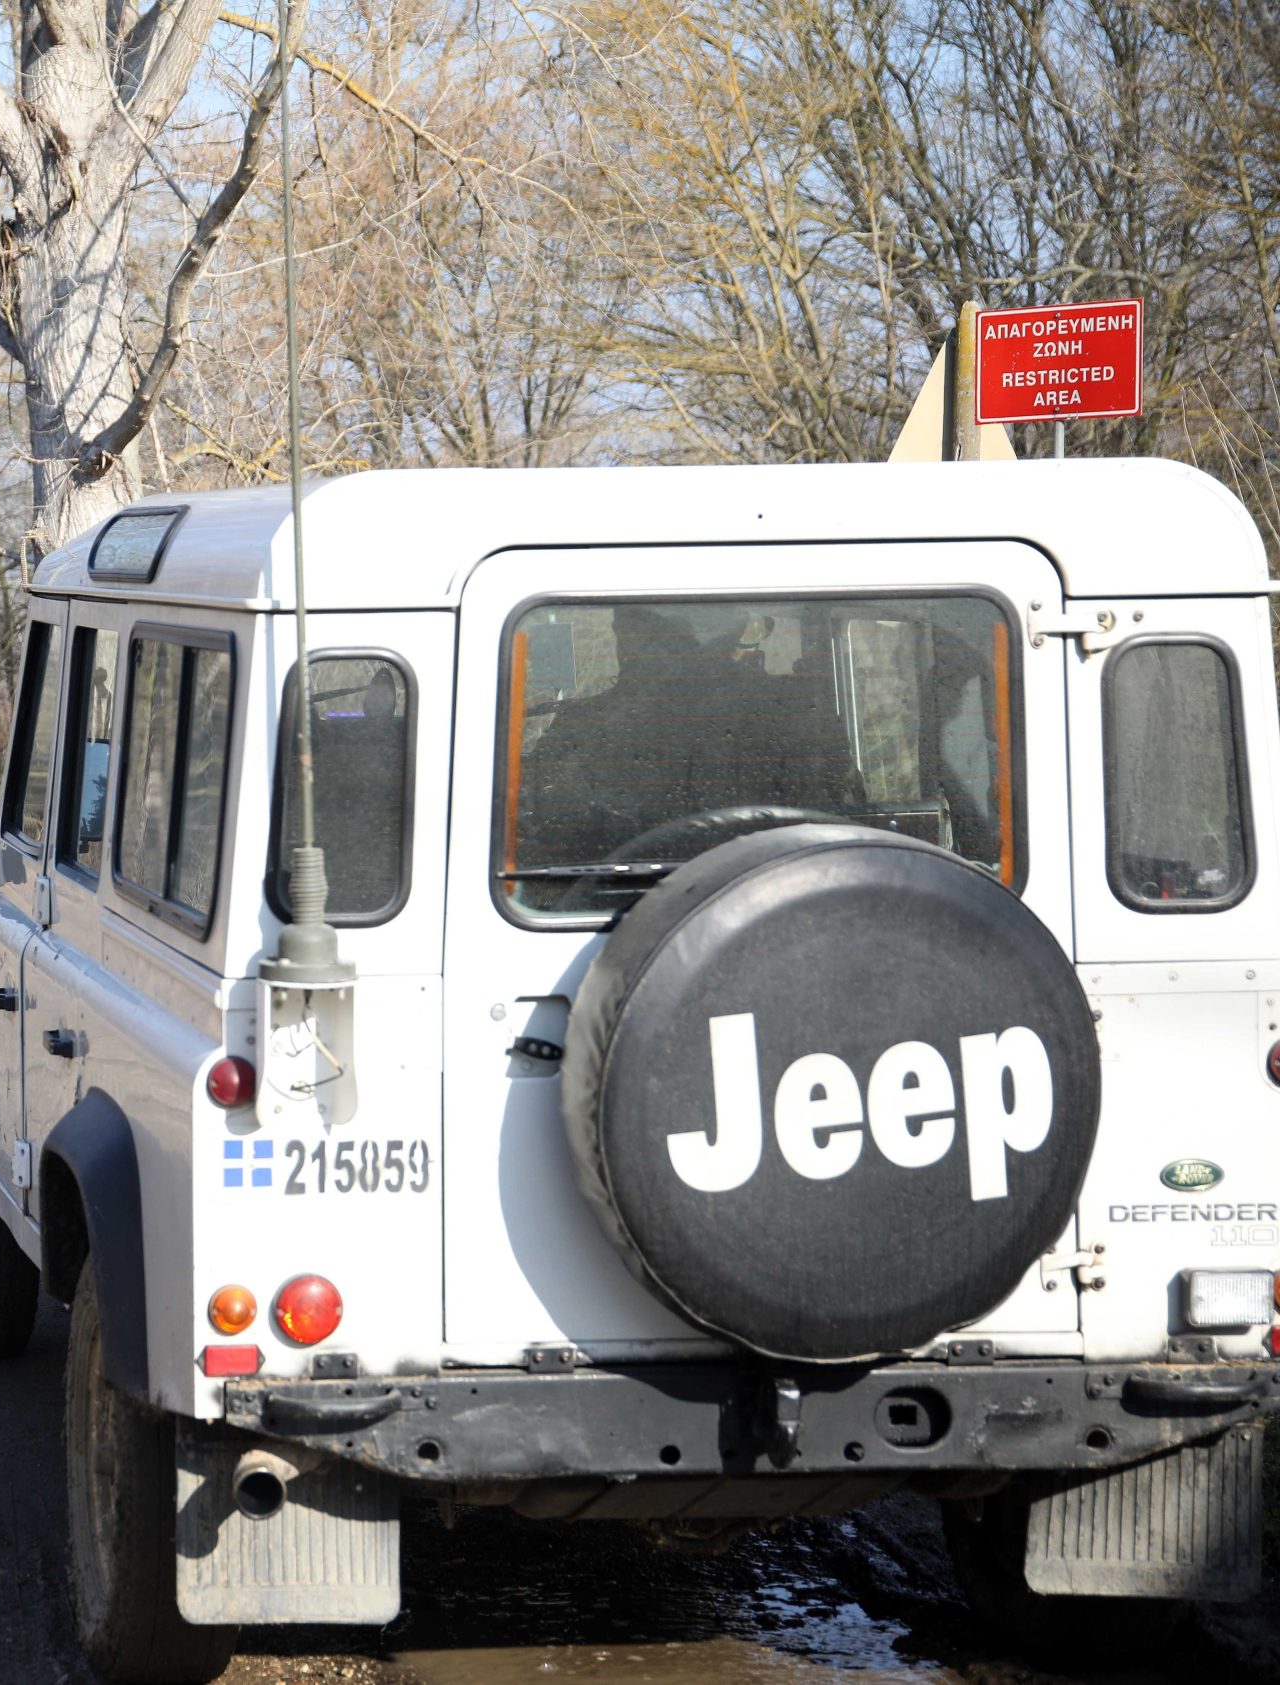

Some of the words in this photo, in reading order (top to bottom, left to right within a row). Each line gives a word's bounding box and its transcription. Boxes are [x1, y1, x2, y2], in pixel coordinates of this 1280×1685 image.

[984, 314, 1133, 340] ΑΠΑΓΟΡΕΥΜΕΝΗ
[1032, 340, 1083, 358] ΖΩΝΗ
[1002, 366, 1115, 387] RESTRICTED
[1033, 390, 1082, 407] AREA
[666, 1012, 1054, 1202] Jeep
[284, 1139, 429, 1195] 215859
[1109, 1203, 1278, 1222] DEFENDER
[1210, 1224, 1280, 1247] 110
